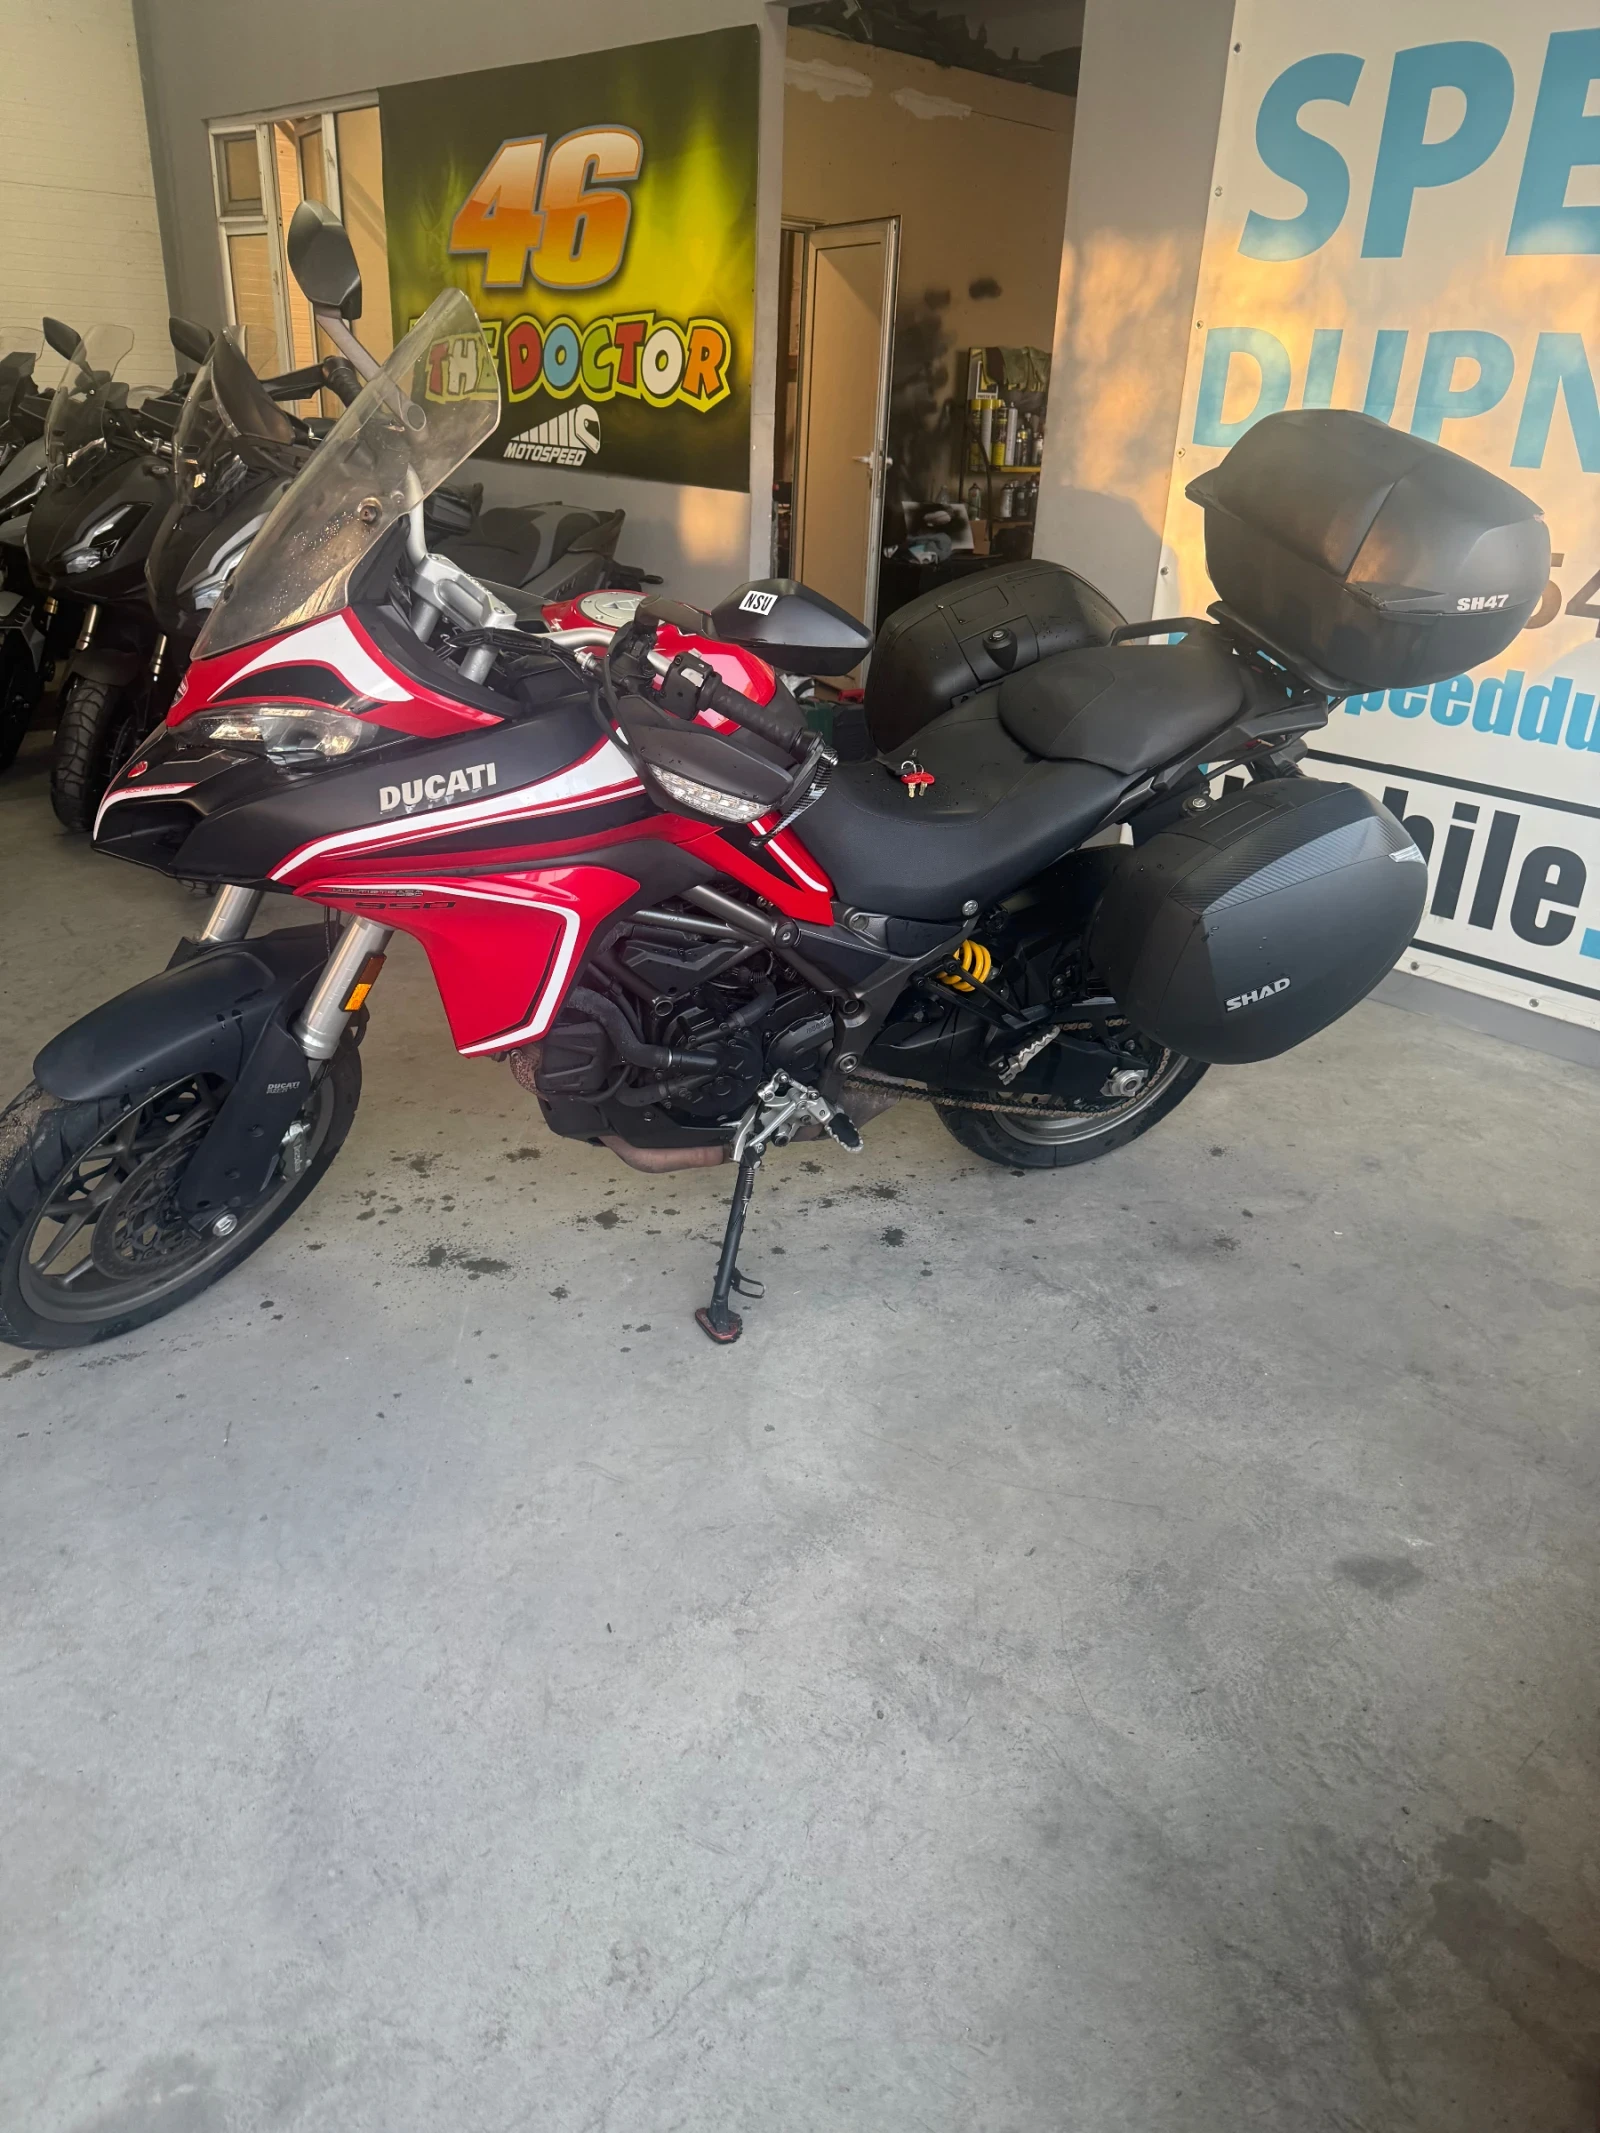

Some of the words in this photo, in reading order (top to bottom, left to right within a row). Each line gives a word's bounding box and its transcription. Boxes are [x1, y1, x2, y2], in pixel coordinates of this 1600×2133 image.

[448, 124, 644, 290] 46
[505, 314, 731, 409] DOCTOR
[503, 441, 587, 467] MOTOSPEED
[743, 593, 773, 611] NSU
[1456, 593, 1509, 611] SH47
[378, 762, 497, 812] DUCATI
[1226, 977, 1291, 1012] SHAD
